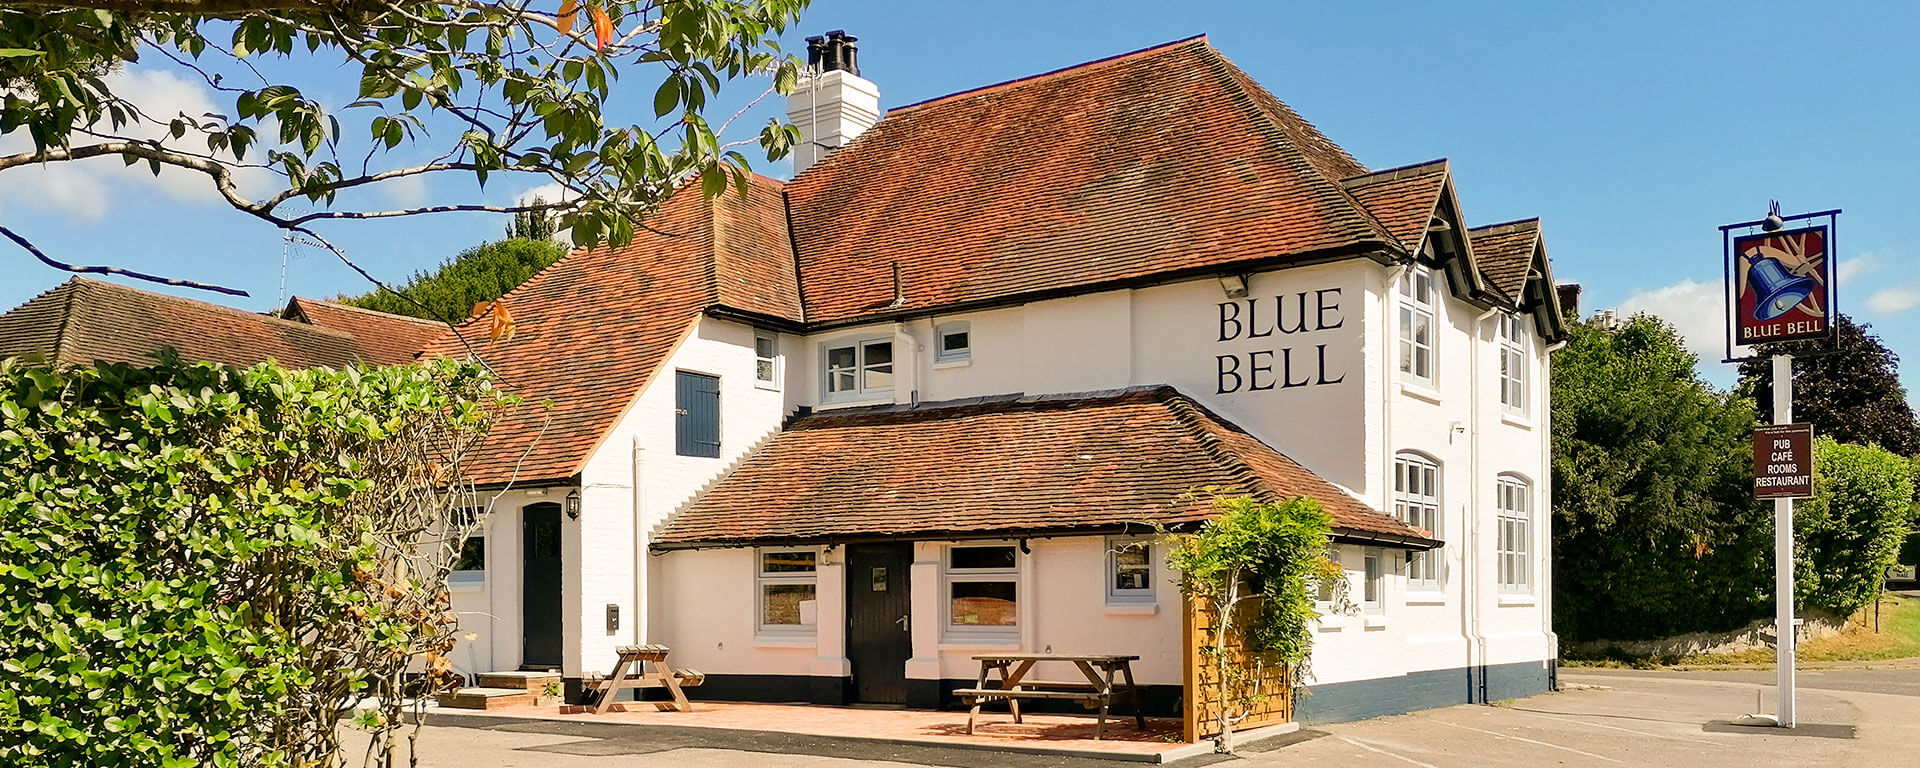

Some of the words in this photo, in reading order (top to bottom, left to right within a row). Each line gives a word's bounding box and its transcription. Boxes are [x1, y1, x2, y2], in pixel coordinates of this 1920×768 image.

[1215, 287, 1345, 342] BLUE
[1743, 323, 1781, 339] BLUE
[1787, 320, 1822, 334] BELL
[1215, 344, 1347, 395] BELL
[1773, 439, 1791, 450] PUB
[1771, 449, 1793, 462] CAFÉ
[1767, 463, 1798, 474] ROOMS
[1755, 475, 1810, 487] RESTAURANT
